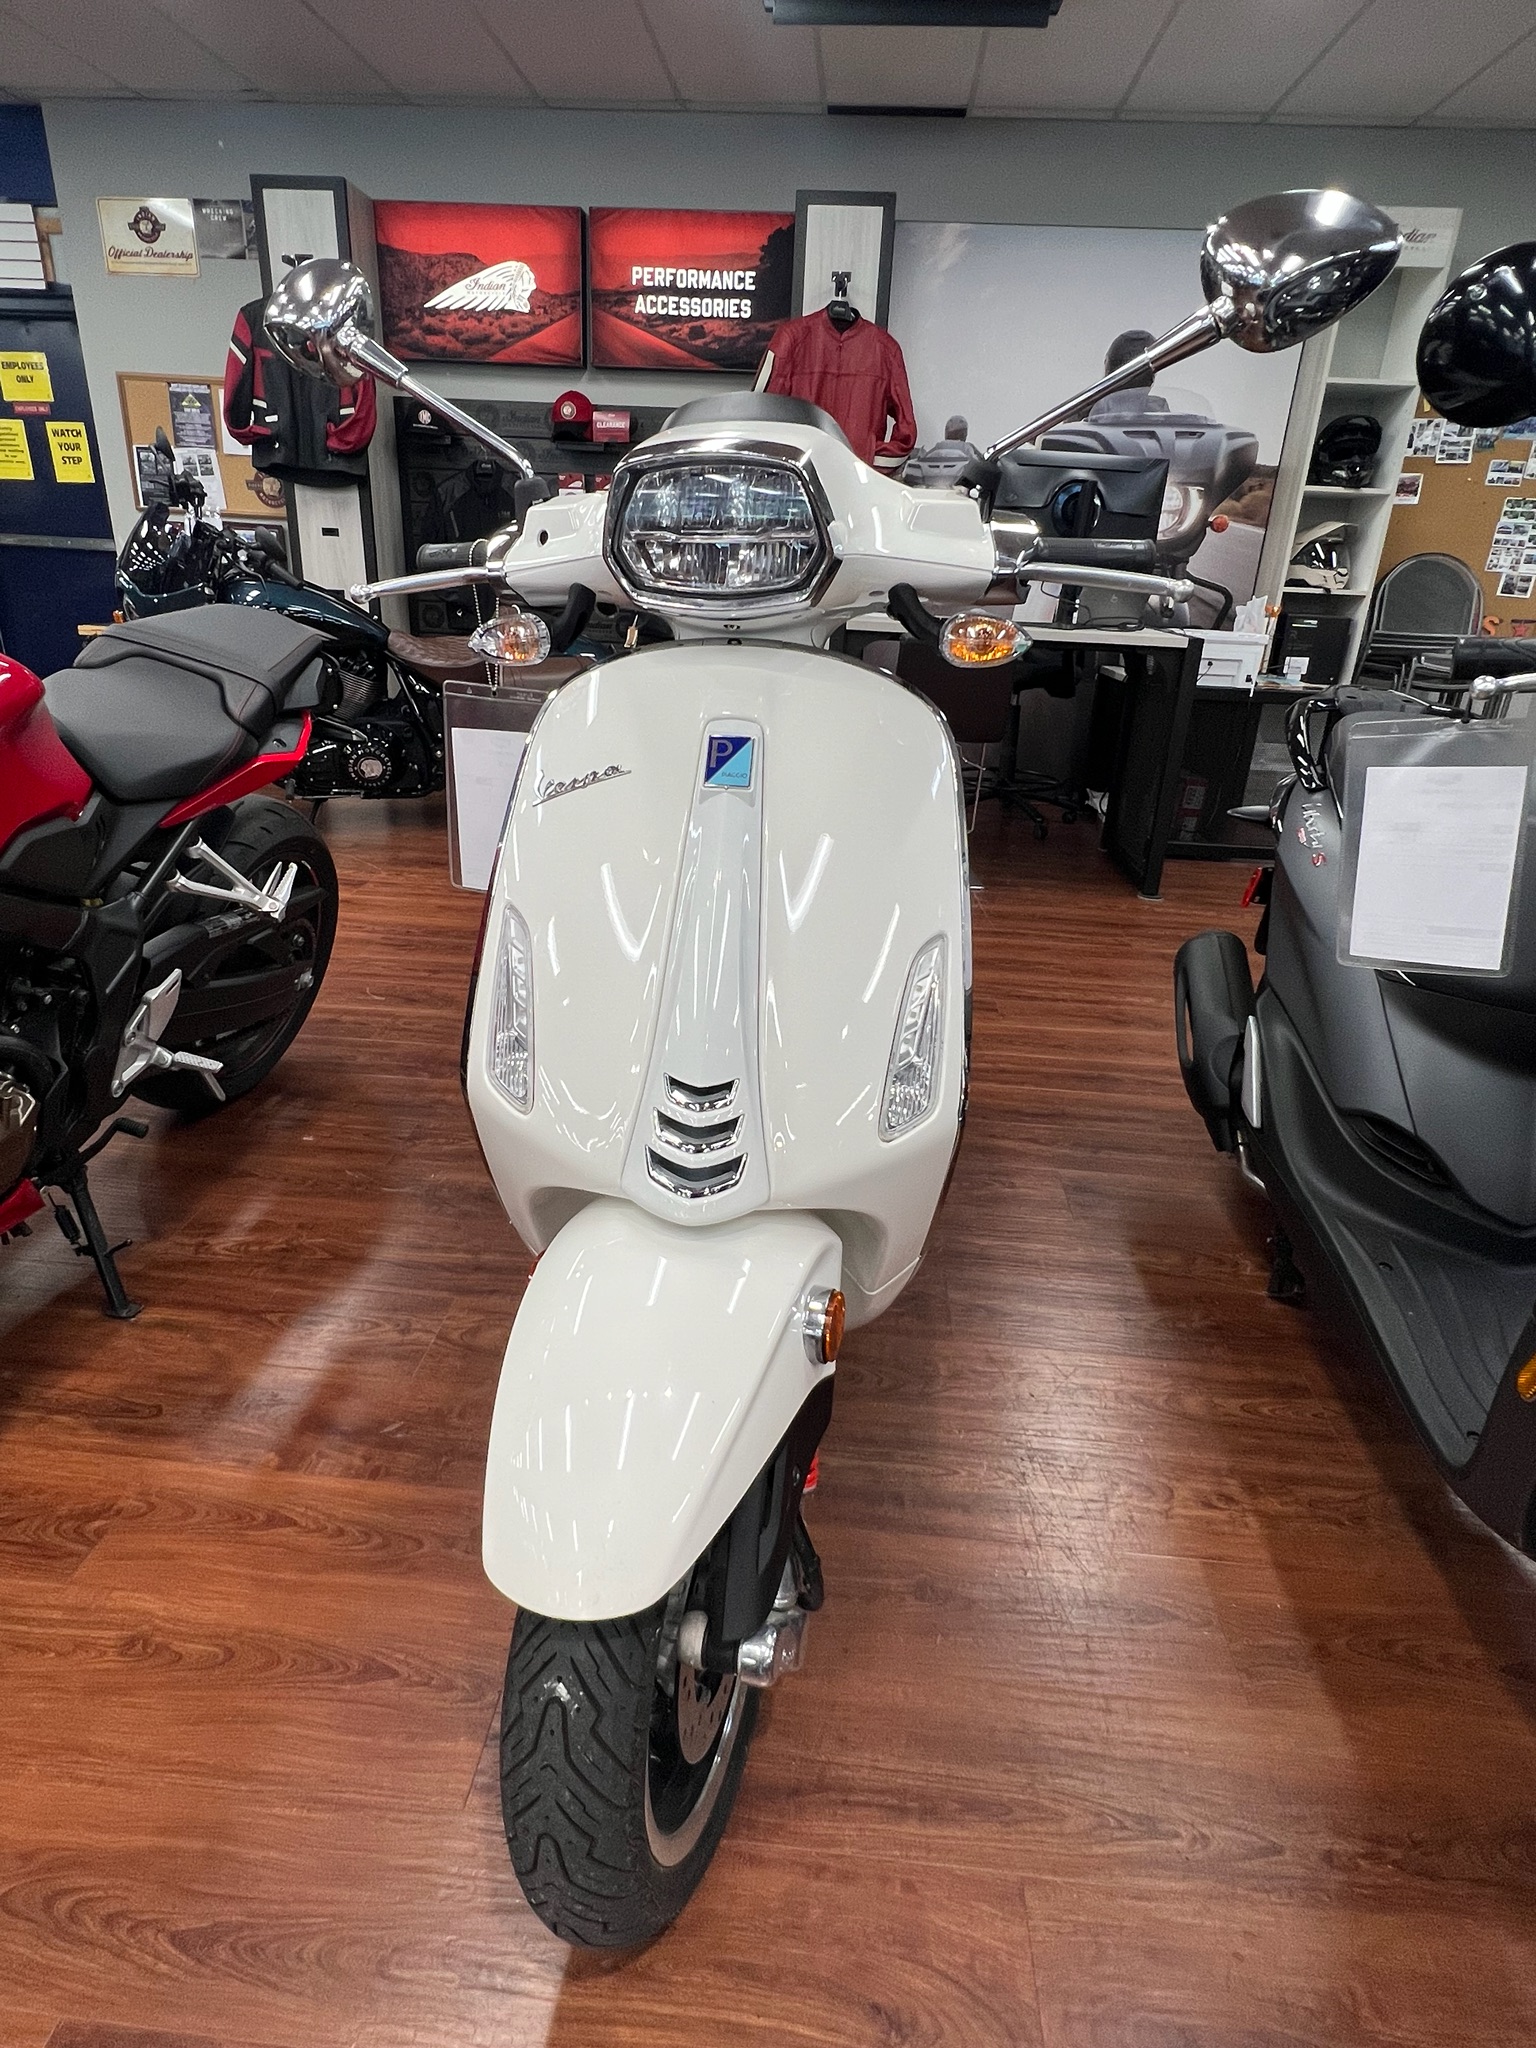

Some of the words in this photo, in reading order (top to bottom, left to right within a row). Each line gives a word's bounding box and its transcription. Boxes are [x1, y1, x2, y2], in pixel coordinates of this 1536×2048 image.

[108, 245, 143, 260] Official
[143, 246, 194, 262] Dealership
[464, 276, 506, 291] Indian
[631, 266, 757, 291] PERFORMANCE
[634, 294, 752, 319] ACCESSORIES
[2, 361, 45, 371] EMPLOYEES
[16, 375, 34, 383] ONLY
[596, 421, 626, 430] CLEARANCE
[51, 428, 83, 438] WATCH
[58, 442, 82, 452] YOUR
[61, 456, 83, 465] STEP
[721, 771, 749, 779] PIAGGIO
[532, 764, 632, 807] Vespa
